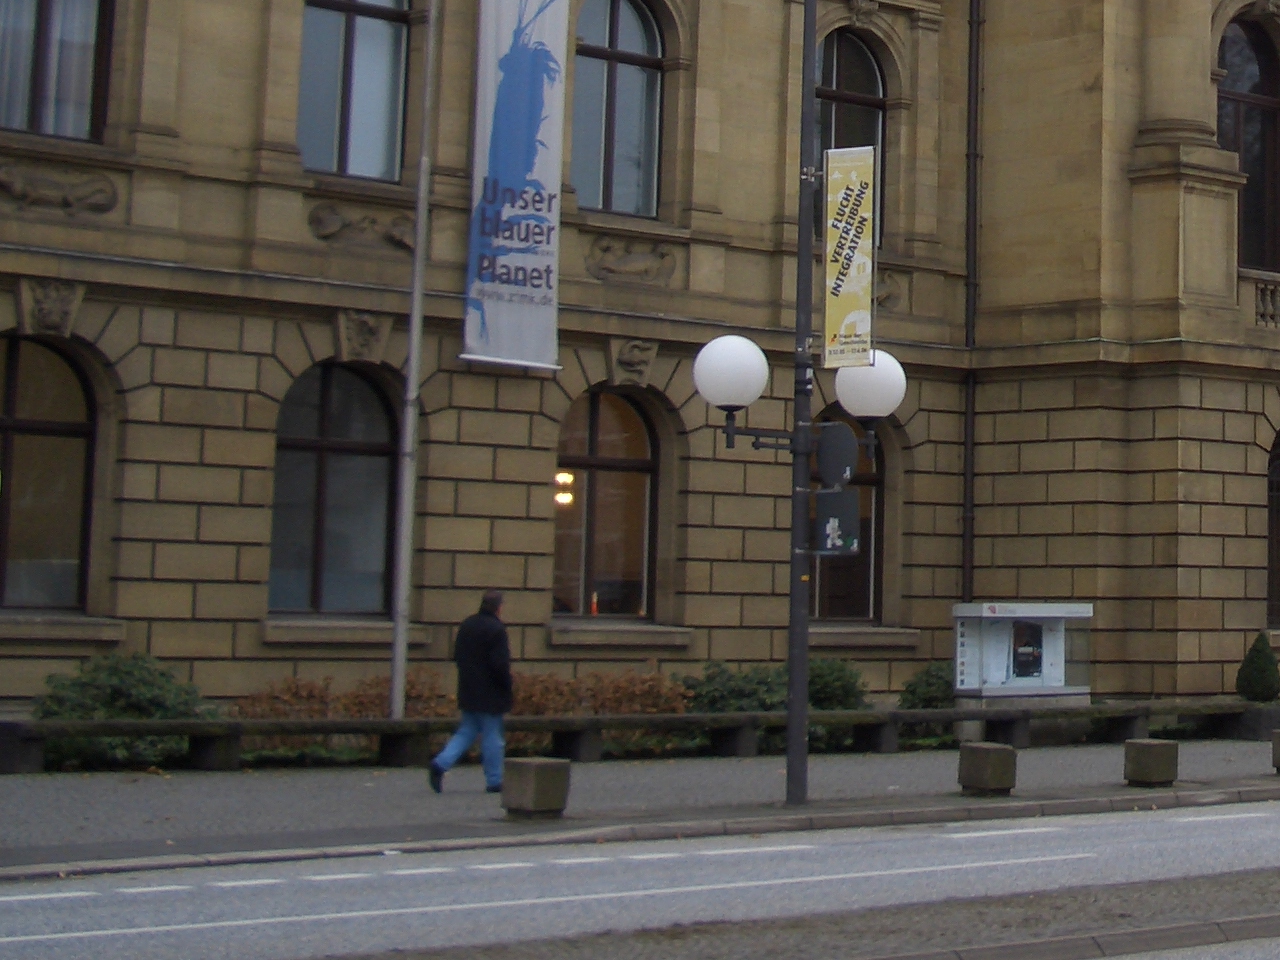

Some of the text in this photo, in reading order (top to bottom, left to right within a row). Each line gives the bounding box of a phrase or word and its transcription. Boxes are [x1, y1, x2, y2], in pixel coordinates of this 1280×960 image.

[482, 176, 557, 213] Unser
[832, 184, 855, 230] FLUCHT
[480, 206, 555, 245] blauer
[830, 179, 869, 264] VERTREIBUNG
[478, 254, 553, 290] Planet
[830, 215, 868, 298] INTEGRATION
